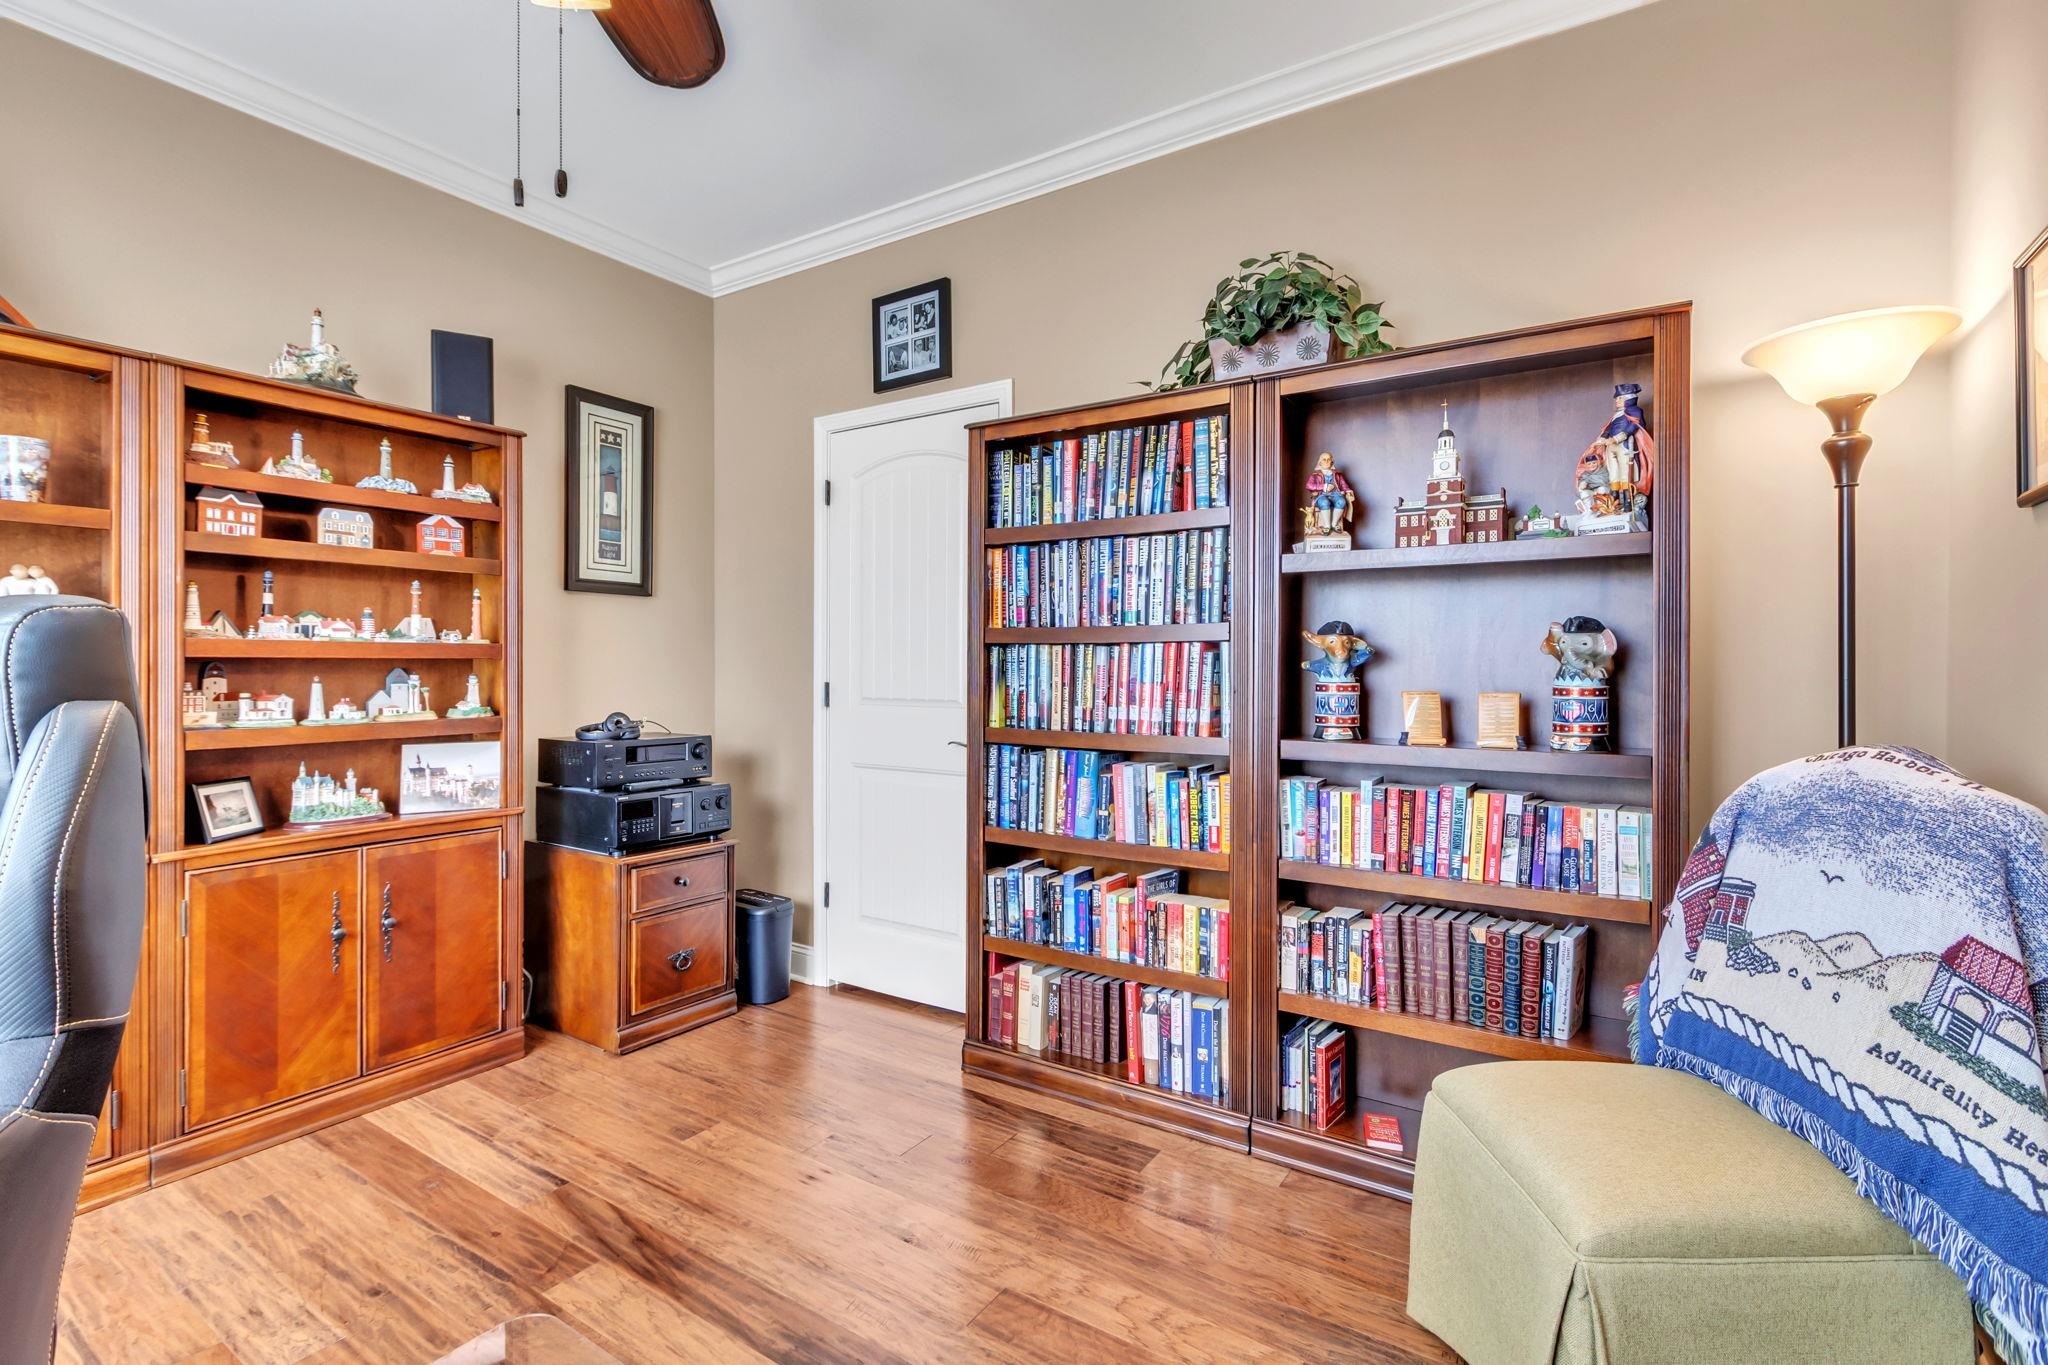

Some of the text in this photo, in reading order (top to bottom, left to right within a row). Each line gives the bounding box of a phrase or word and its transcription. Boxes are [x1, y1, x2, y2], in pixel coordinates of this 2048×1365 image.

[1218, 438, 1227, 477] Tom Clancy
[1587, 702, 1596, 713] 6
[988, 767, 996, 798] SANDFORD
[1805, 750, 1869, 764] Chicago
[1960, 780, 1986, 793] IL
[1190, 789, 1200, 844] ROBERT CRAIS
[1306, 792, 1316, 840] MICHAEL PALMER
[1401, 801, 1410, 852] JAMES PATTERSON
[1425, 802, 1437, 853] JAMES PATTERSON
[1440, 798, 1451, 849] JAMES PATTERSON
[1451, 797, 1464, 869] JAMES PATTERSON INN
[1476, 815, 1484, 831] JAMES
[1540, 833, 1546, 841] ON
[1169, 879, 1176, 888] OF
[1563, 858, 1571, 878] CAUSE
[1569, 857, 1578, 889] GLORIOUS
[1546, 945, 1554, 959] John
[1160, 1014, 1171, 1038] 1776
[1866, 1042, 1998, 1129] Admirality
